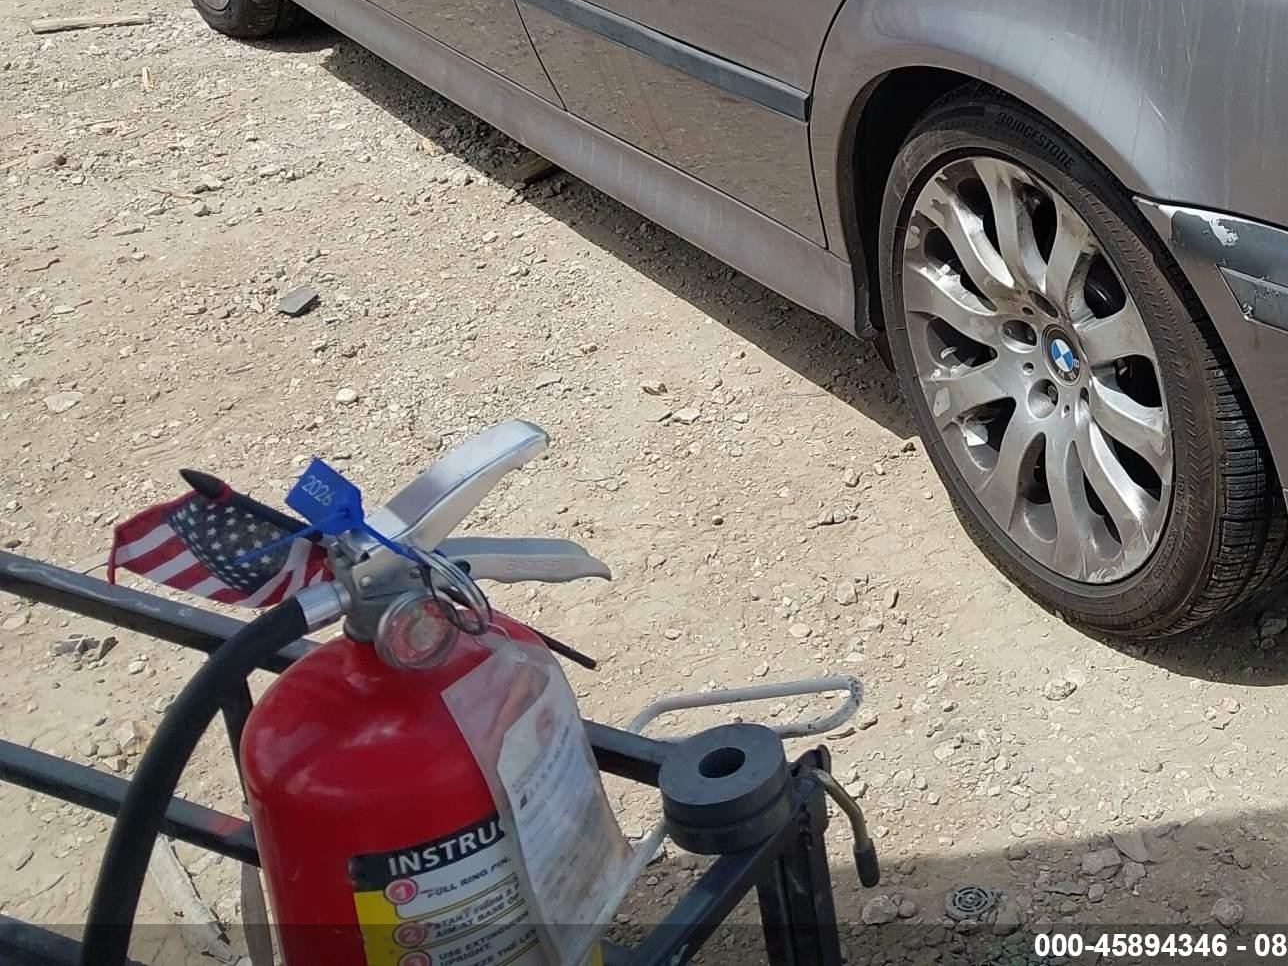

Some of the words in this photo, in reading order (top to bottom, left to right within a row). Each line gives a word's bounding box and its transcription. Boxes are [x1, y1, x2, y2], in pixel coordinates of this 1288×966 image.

[995, 112, 1076, 171] BRIDGESTONE
[301, 474, 335, 507] 2026
[460, 869, 488, 887] RING
[439, 947, 461, 960] USE
